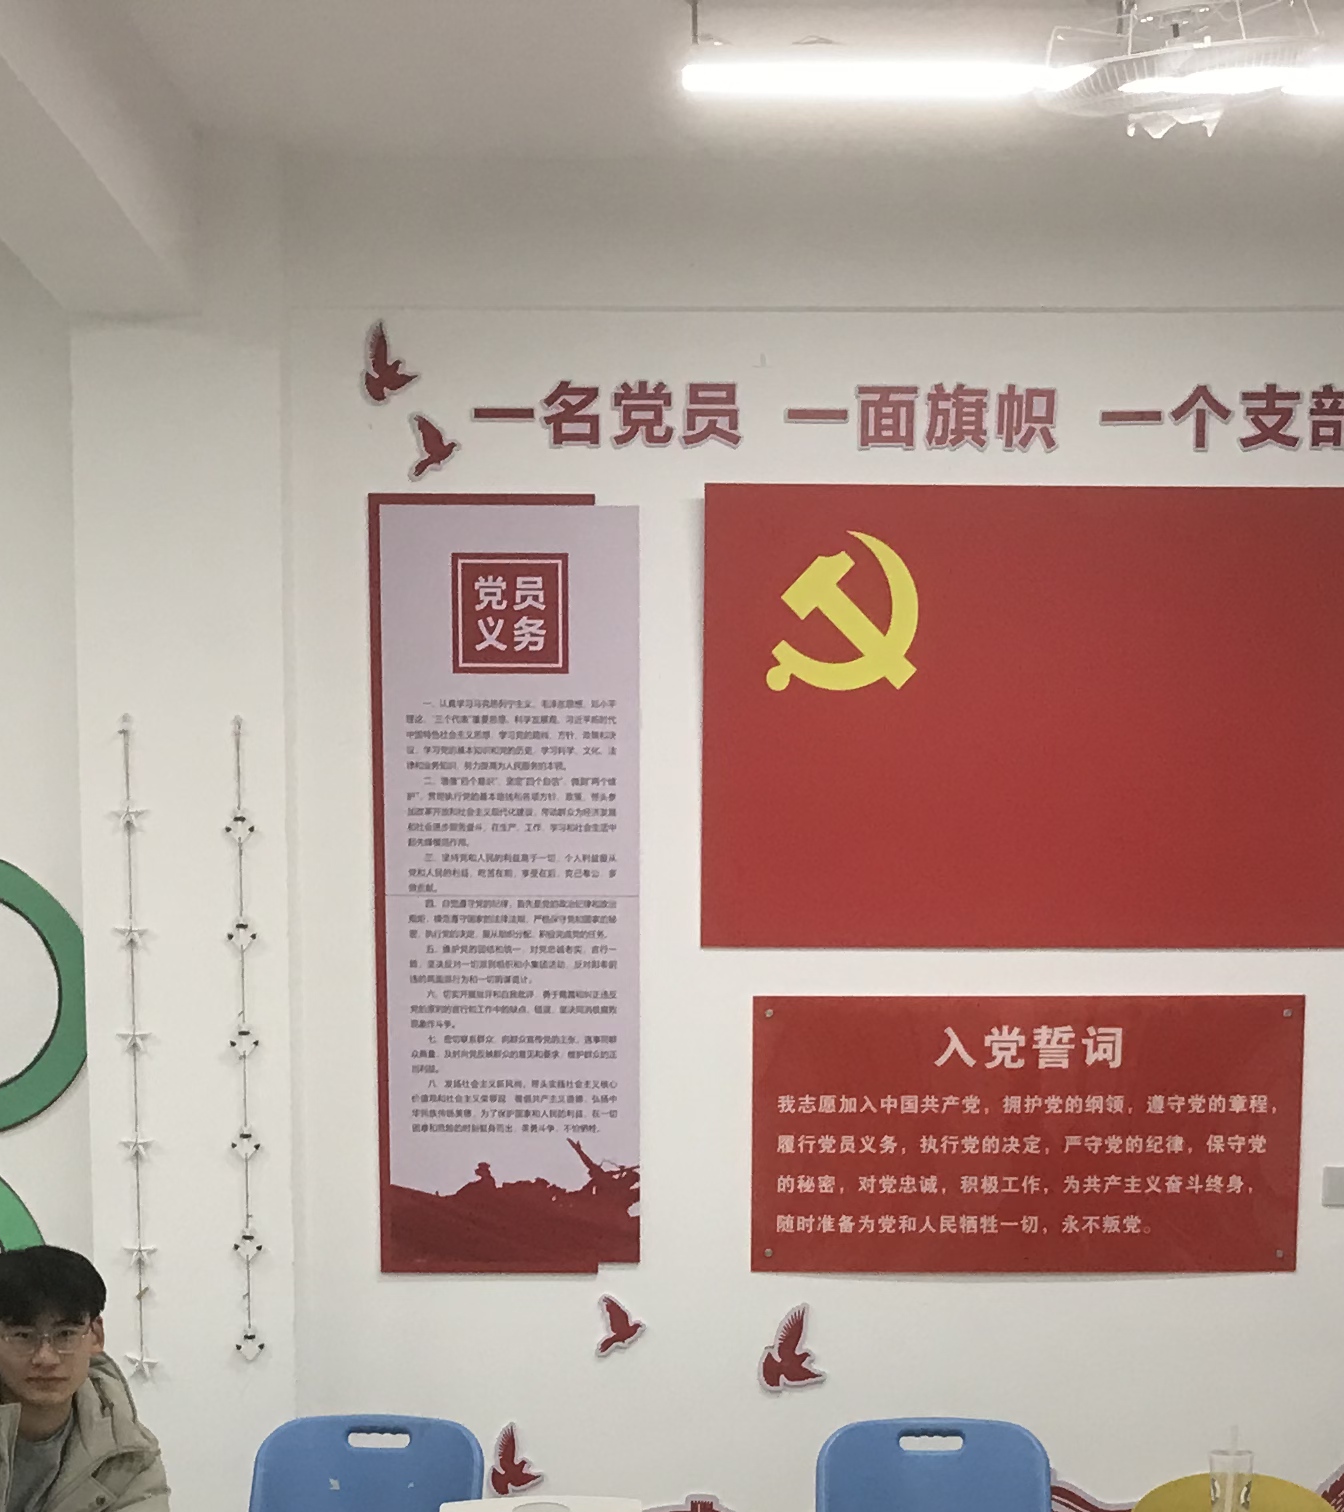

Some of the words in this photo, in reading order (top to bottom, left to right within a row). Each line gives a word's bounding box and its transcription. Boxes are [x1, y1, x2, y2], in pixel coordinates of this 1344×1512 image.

[472, 380, 743, 448] 一名党员
[787, 383, 1059, 450] 一面旗帜
[474, 574, 547, 612] 党员
[474, 616, 547, 652] 义务
[933, 1024, 1125, 1070] 入党誓词
[776, 1094, 1279, 1116] 我志愿加入中国共产党，拥护党的纲领，遵守党的章程，
[776, 1134, 1268, 1156] 履行党员义务，执行党的决定，严守党的纪律，保守党
[776, 1173, 1256, 1196] 的秘密，对党忠诚，积极工作，为共产主义奋斗终身，
[776, 1213, 1153, 1236] 随时准备为党和人民牺牲一切，永不叛党。
